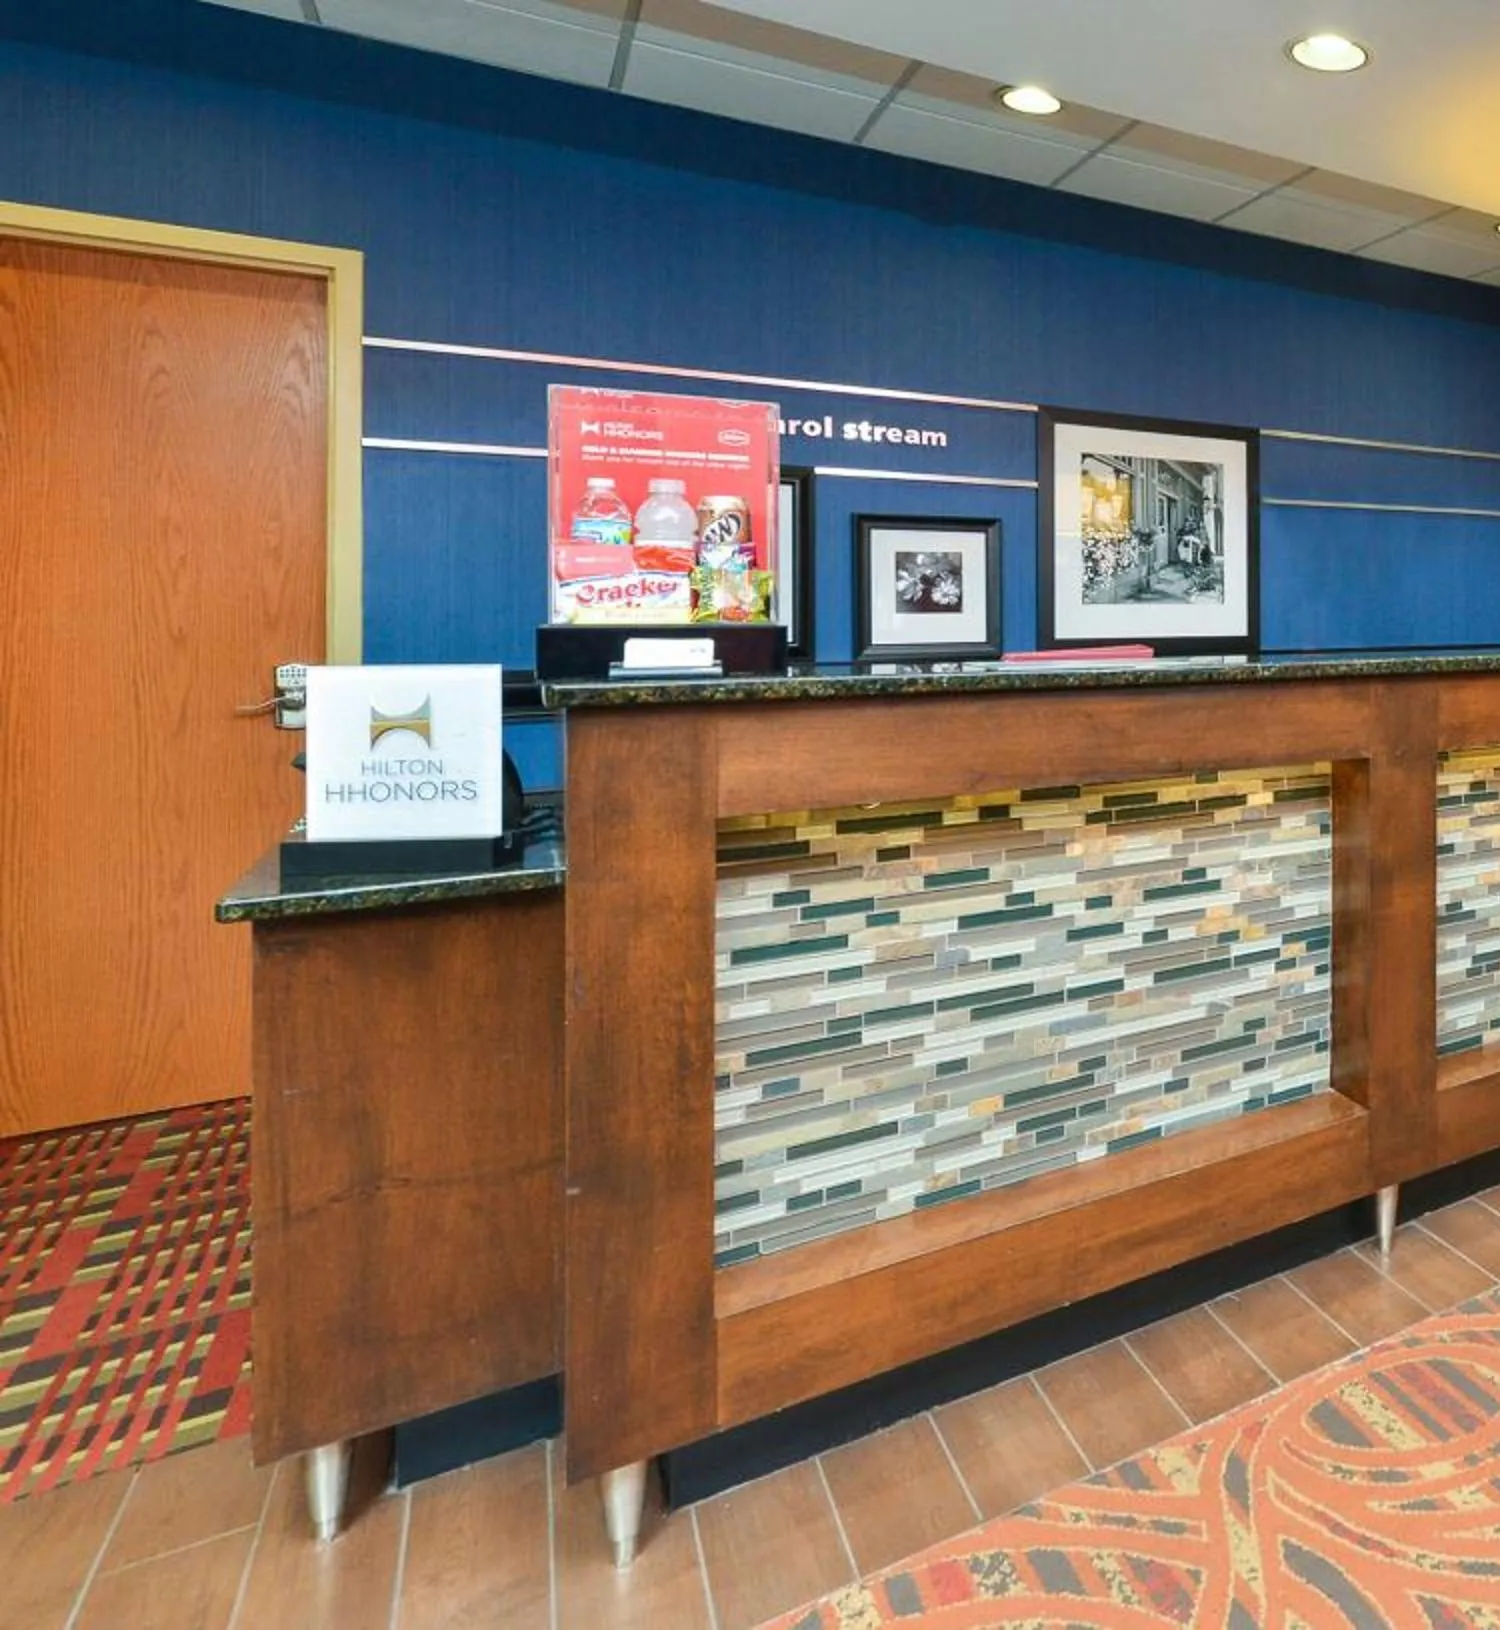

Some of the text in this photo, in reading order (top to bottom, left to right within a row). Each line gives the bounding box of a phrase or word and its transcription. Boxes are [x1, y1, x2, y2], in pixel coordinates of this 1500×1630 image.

[776, 416, 833, 438] arol
[843, 420, 947, 447] stream
[575, 577, 678, 608] Cracker
[361, 758, 444, 776] HILTON
[325, 780, 478, 804] HHONORS
